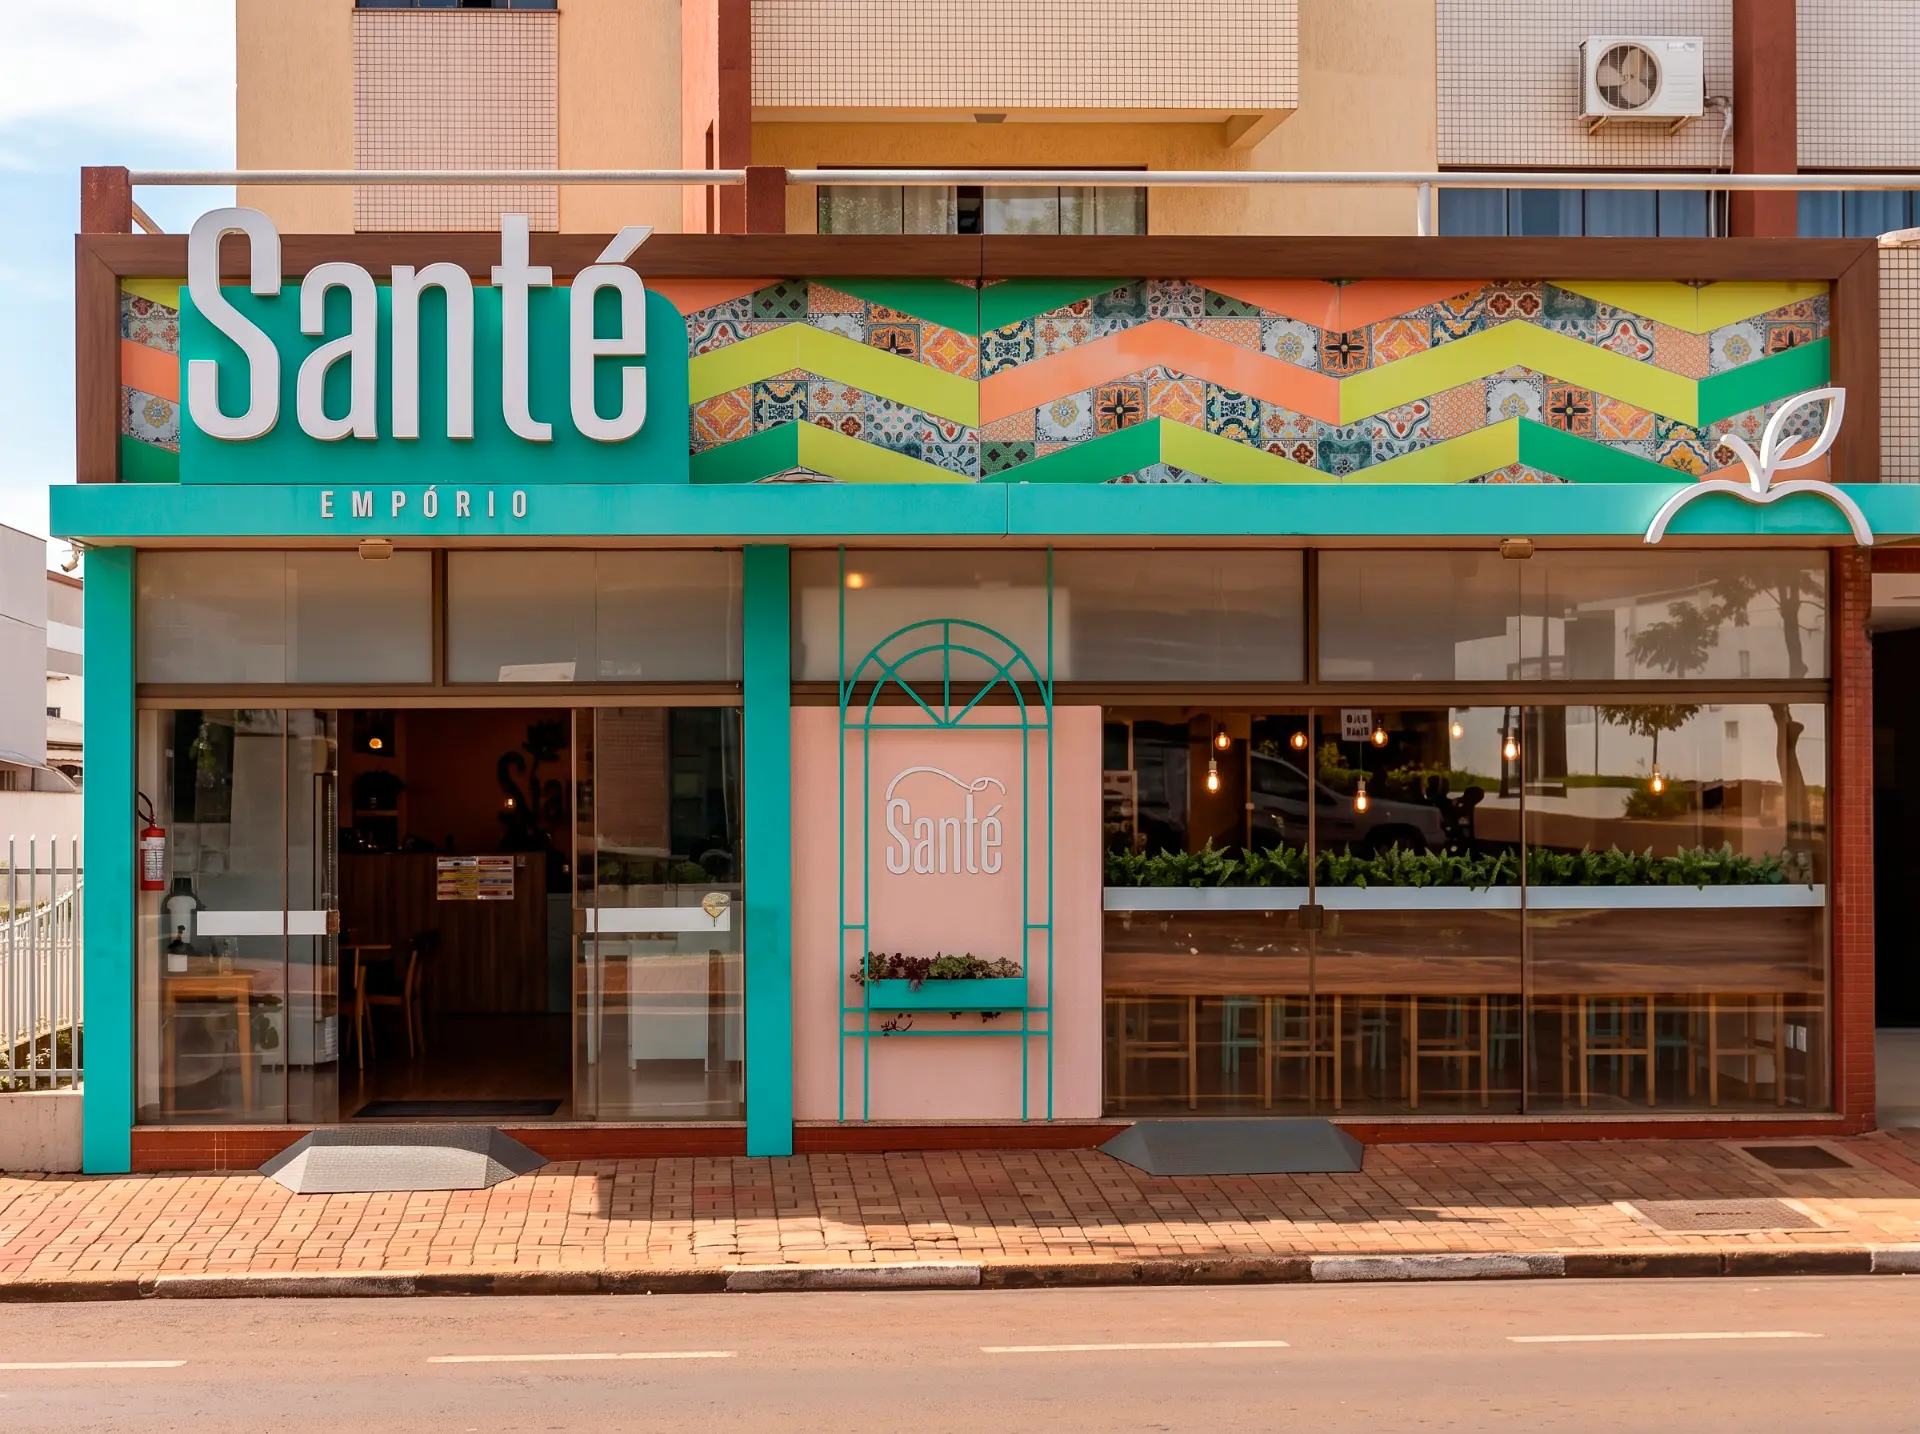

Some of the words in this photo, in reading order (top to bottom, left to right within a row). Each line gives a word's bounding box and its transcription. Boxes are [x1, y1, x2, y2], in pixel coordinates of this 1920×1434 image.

[188, 207, 654, 442] Santé
[321, 484, 528, 518] EMPÓRIO
[886, 794, 1003, 875] Santé
